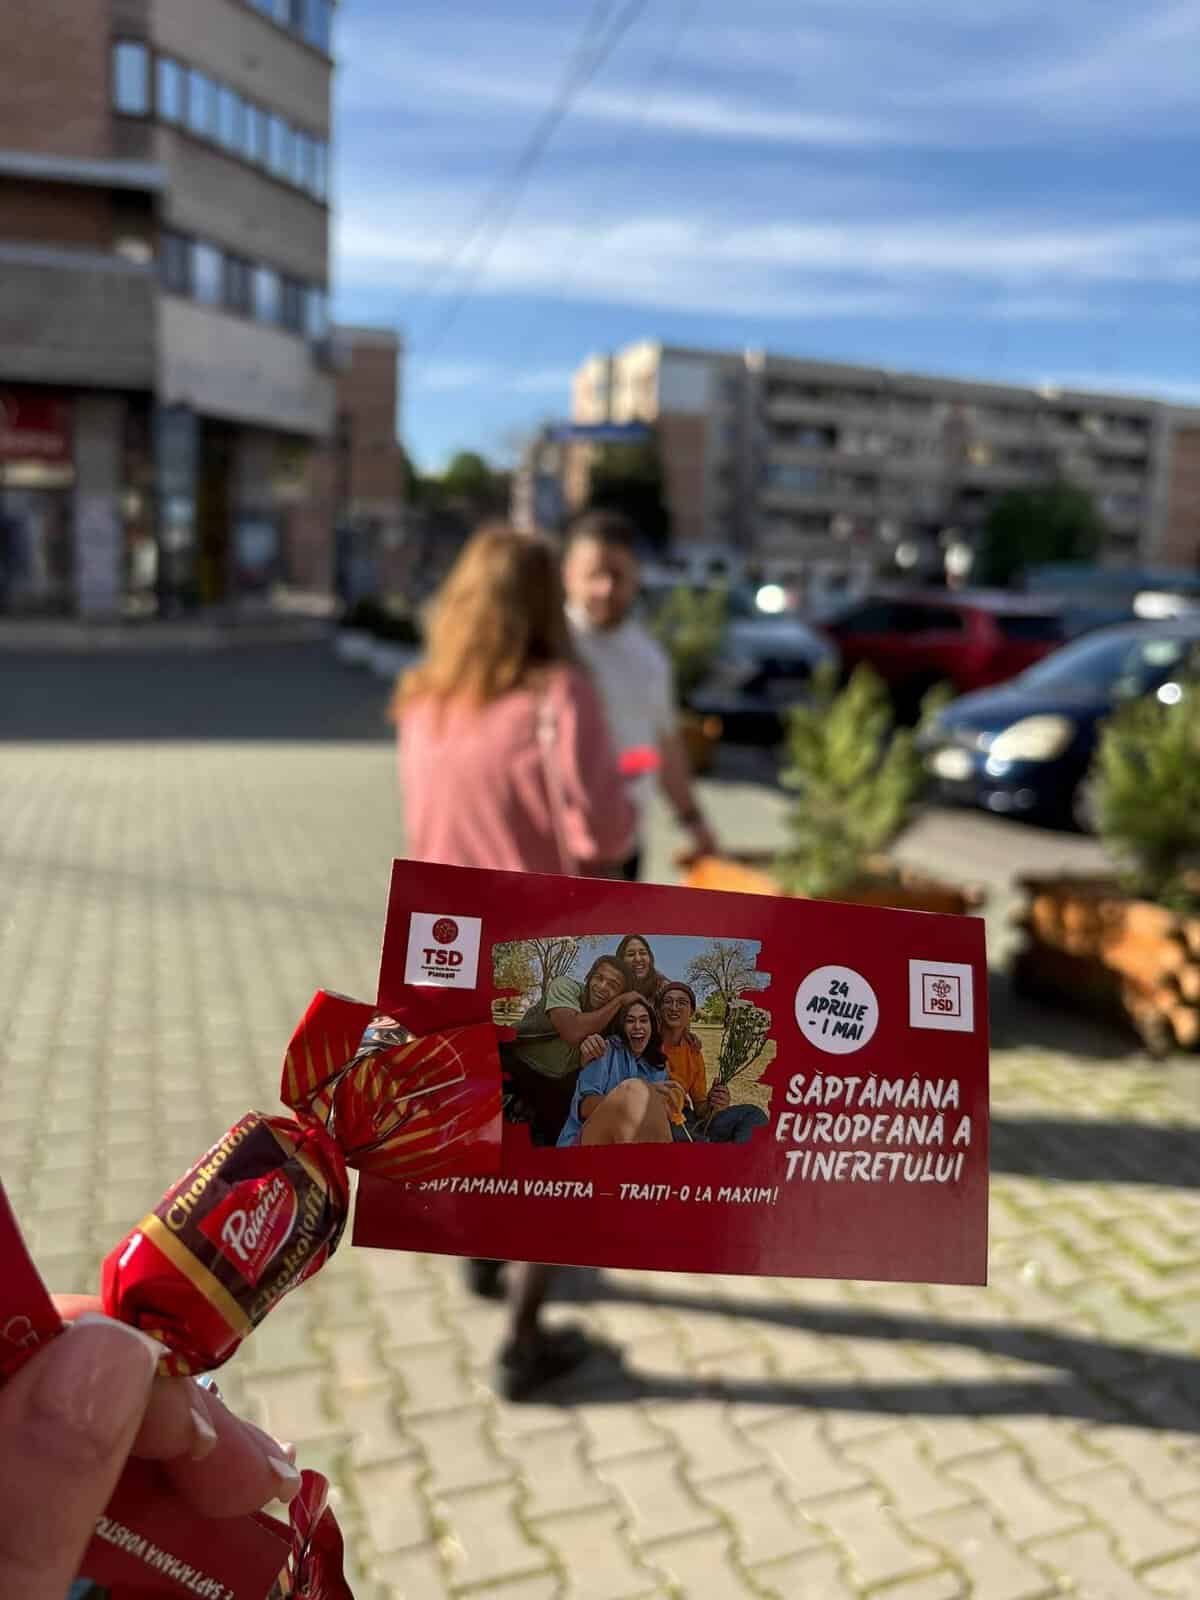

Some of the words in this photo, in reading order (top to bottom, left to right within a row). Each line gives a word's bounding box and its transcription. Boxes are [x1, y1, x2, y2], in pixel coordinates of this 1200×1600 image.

[422, 948, 464, 966] TSD
[828, 979, 850, 998] 24
[806, 995, 869, 1021] APRILIE
[930, 998, 953, 1012] PSD
[831, 1020, 865, 1041] MAI
[952, 1114, 972, 1147] A
[784, 1149, 965, 1184] TINERETULUI
[523, 1179, 594, 1199] VOASTRA
[694, 1185, 713, 1203] LA
[716, 1186, 779, 1206] MAXIM!
[221, 1176, 286, 1261] Poiana
